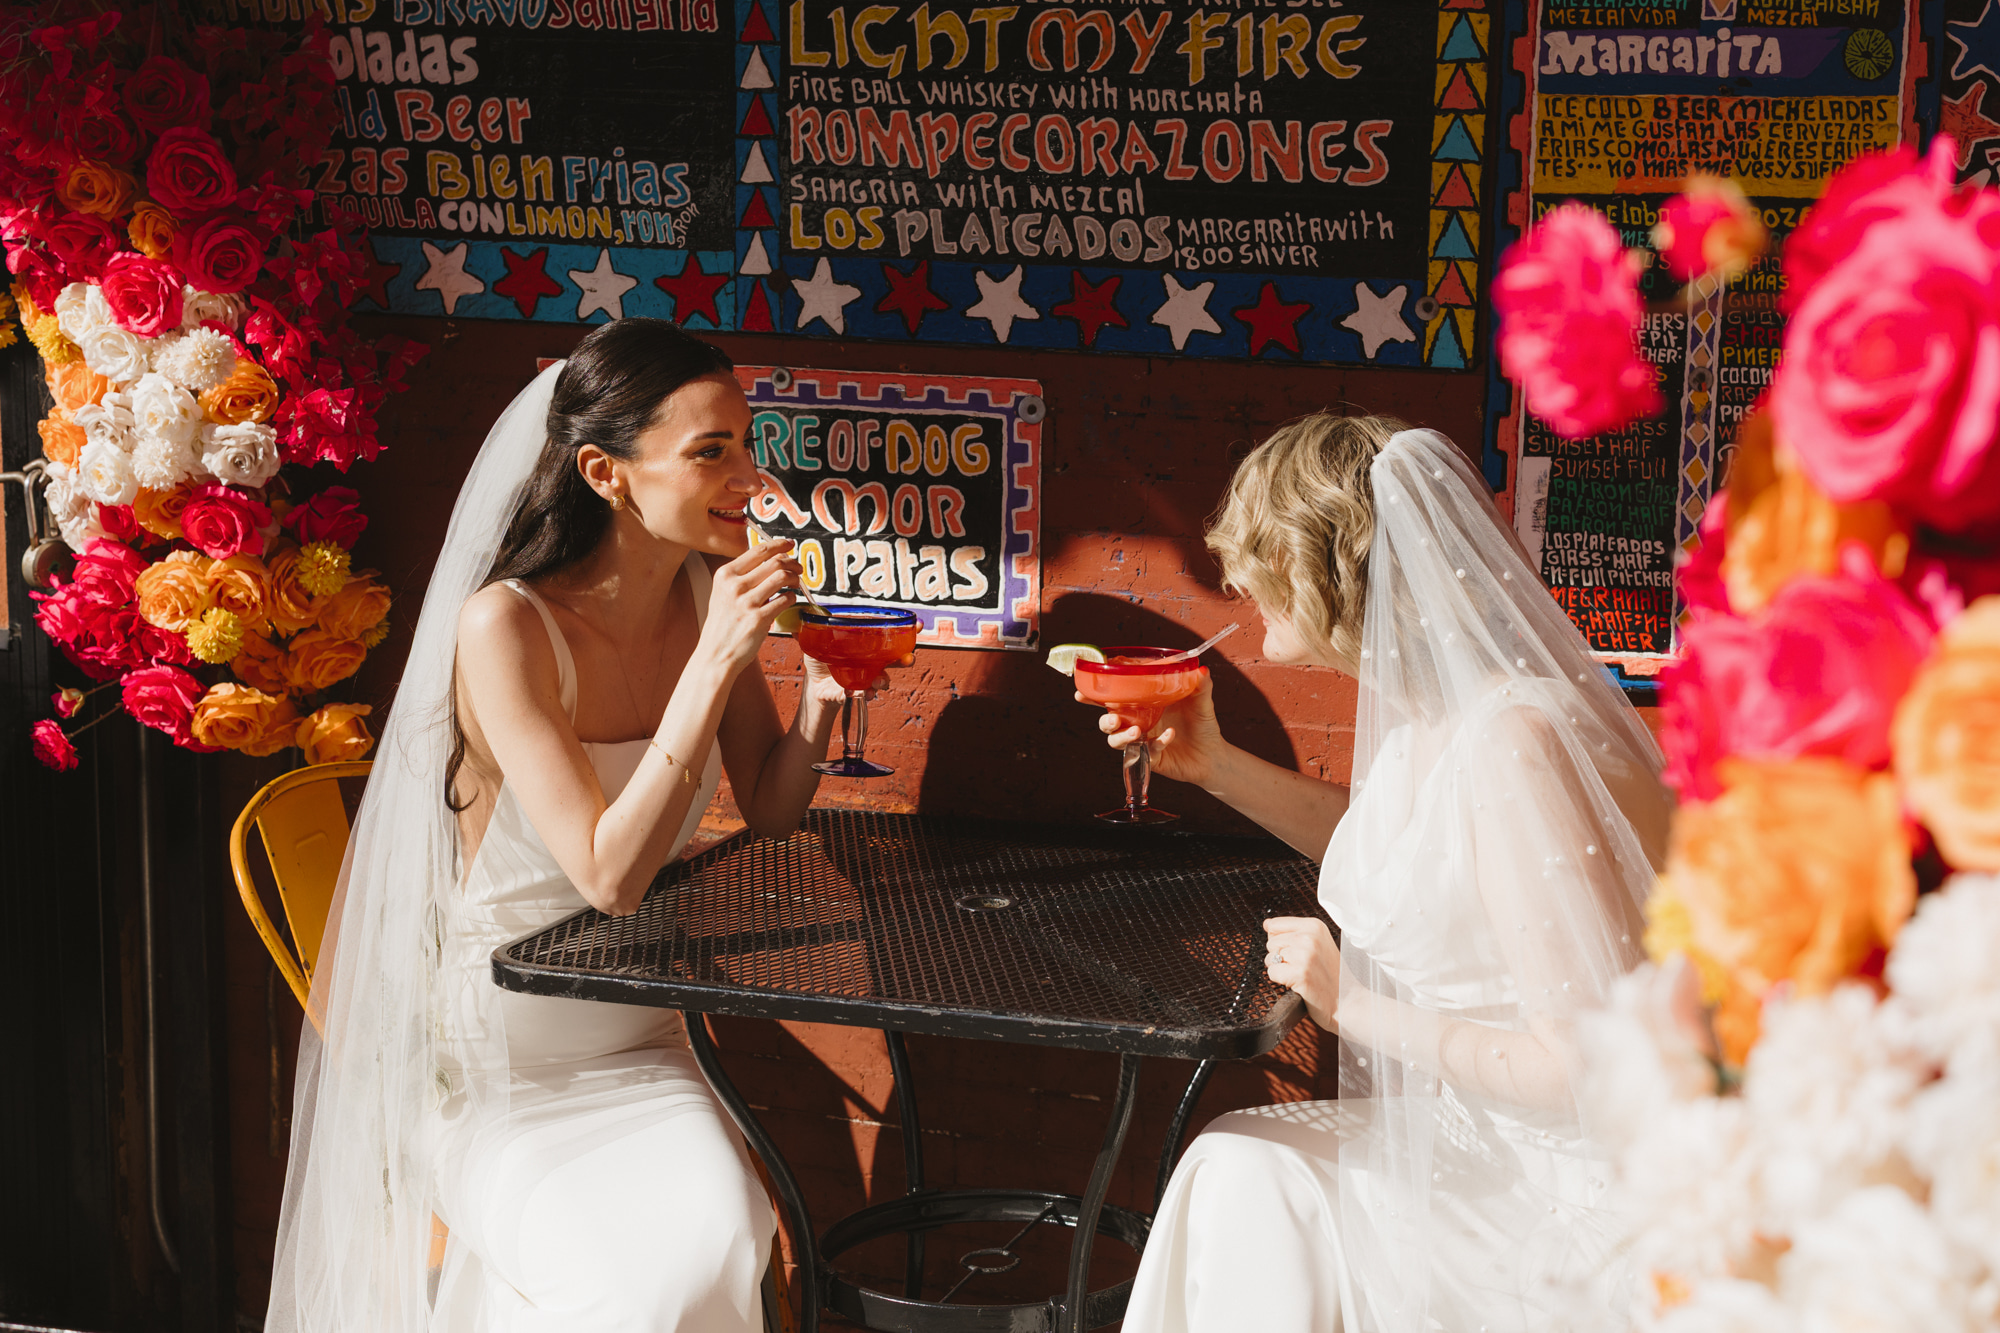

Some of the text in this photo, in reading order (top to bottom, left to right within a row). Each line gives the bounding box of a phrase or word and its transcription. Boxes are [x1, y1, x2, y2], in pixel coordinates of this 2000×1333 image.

[328, 27, 480, 85] oladas
[1176, 7, 1367, 87] FIRE
[851, 78, 911, 105] BALL
[1544, 97, 1888, 122] ICE COLD BEER MICHELADAS
[394, 88, 531, 144] Beer
[1722, 121, 1761, 141] LAS
[1769, 122, 1874, 141] CERVEZAS
[786, 103, 1394, 187] ROMPECORAZONES
[1539, 137, 1600, 158] FRIAS
[426, 139, 553, 202] Bien
[562, 146, 691, 208] Frias
[438, 201, 505, 234] CON
[790, 203, 885, 250] LOS
[1174, 247, 1234, 270] 1800
[885, 419, 990, 477] DOG
